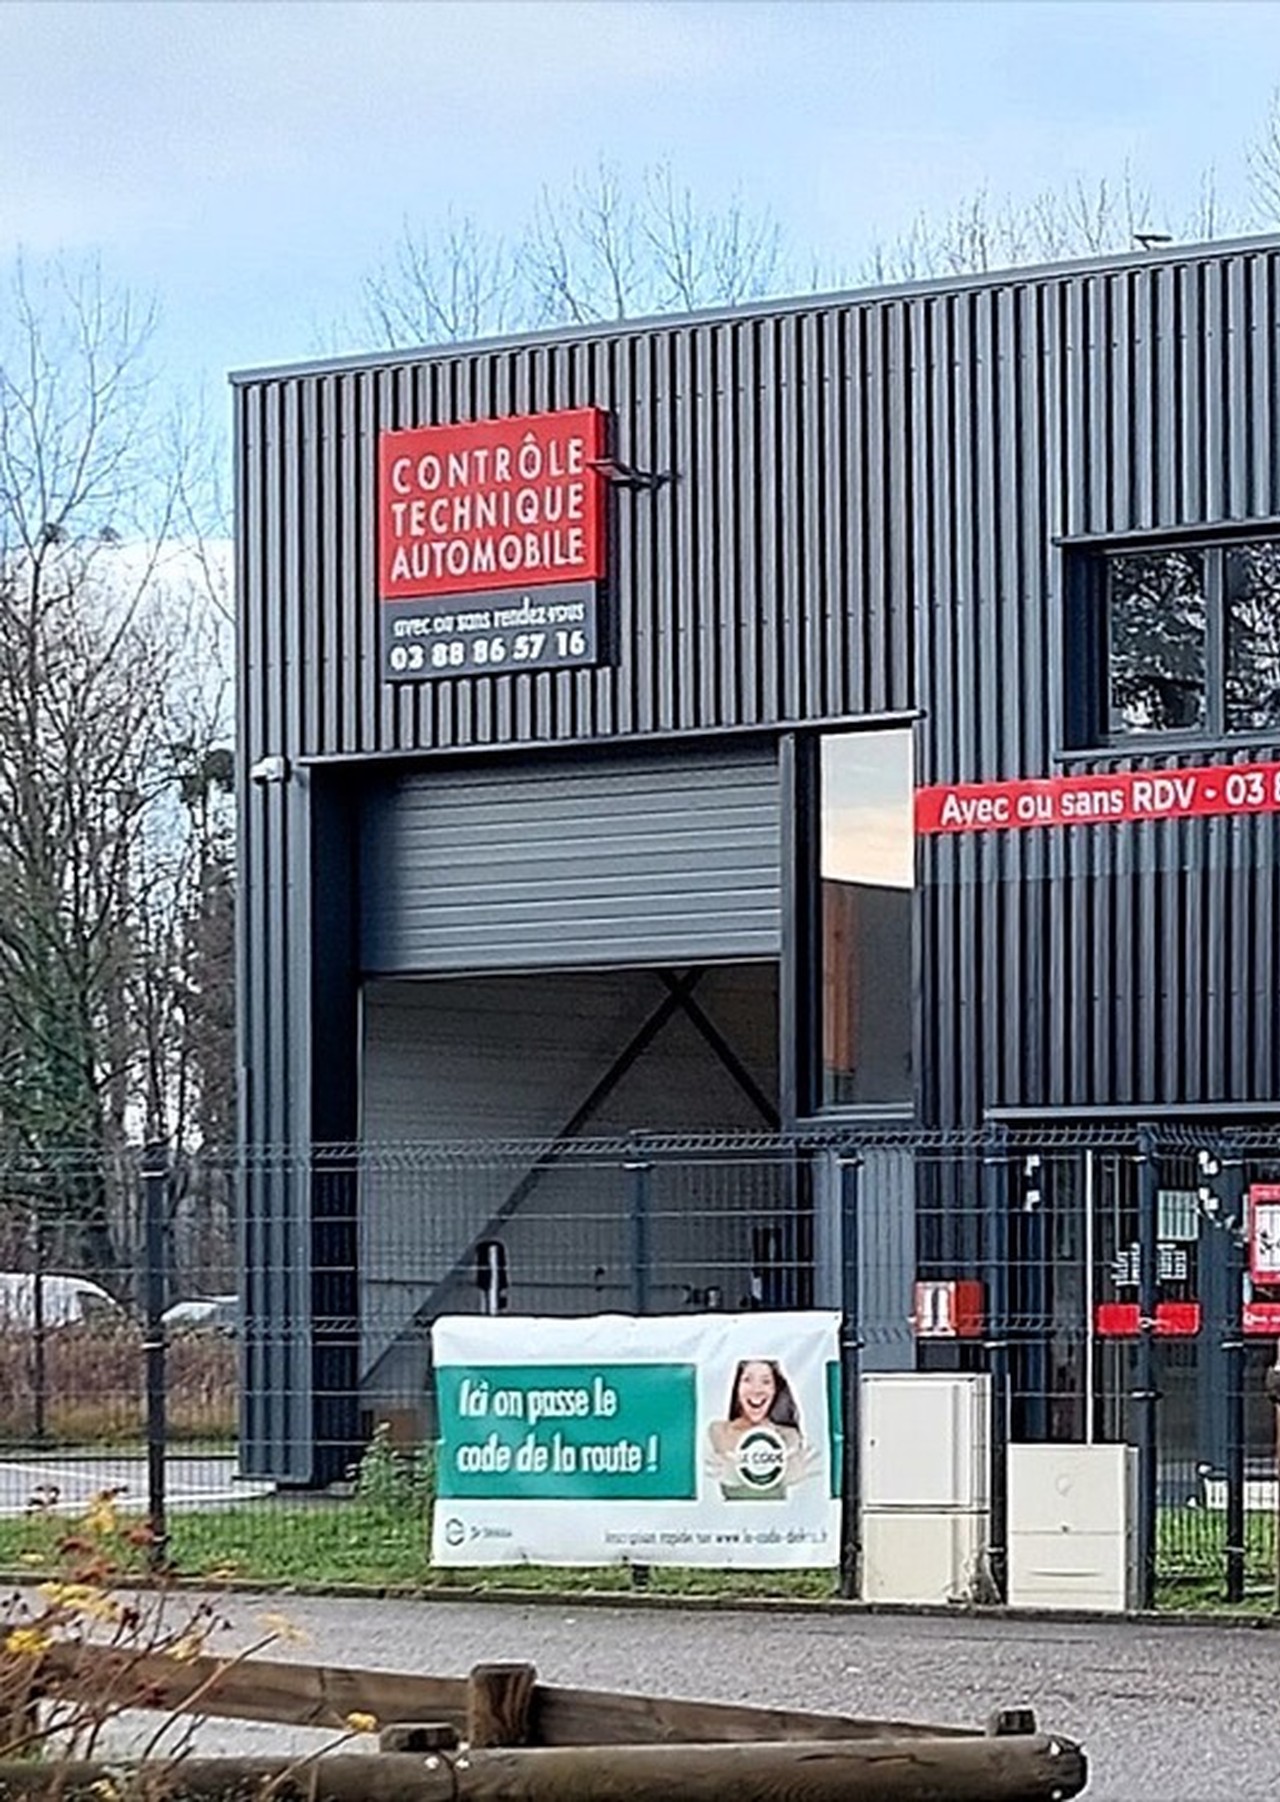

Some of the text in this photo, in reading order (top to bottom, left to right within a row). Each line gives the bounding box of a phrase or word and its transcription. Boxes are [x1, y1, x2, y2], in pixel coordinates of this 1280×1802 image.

[392, 431, 584, 494] CONTRÔLE
[391, 483, 584, 537] TECHNIQUE
[390, 528, 585, 583] AUTOMOBILE
[394, 618, 432, 637] avec
[433, 616, 453, 633] ou
[457, 611, 490, 631] sans
[391, 630, 586, 671] 03 88 86 57 16
[940, 794, 1009, 826] Avec
[1017, 793, 1052, 818] ou
[1061, 788, 1124, 816] sans
[1132, 777, 1197, 812] RDV
[1226, 773, 1264, 805] 03
[459, 1376, 617, 1426] Ici on passe le
[457, 1432, 659, 1472] code de la route !
